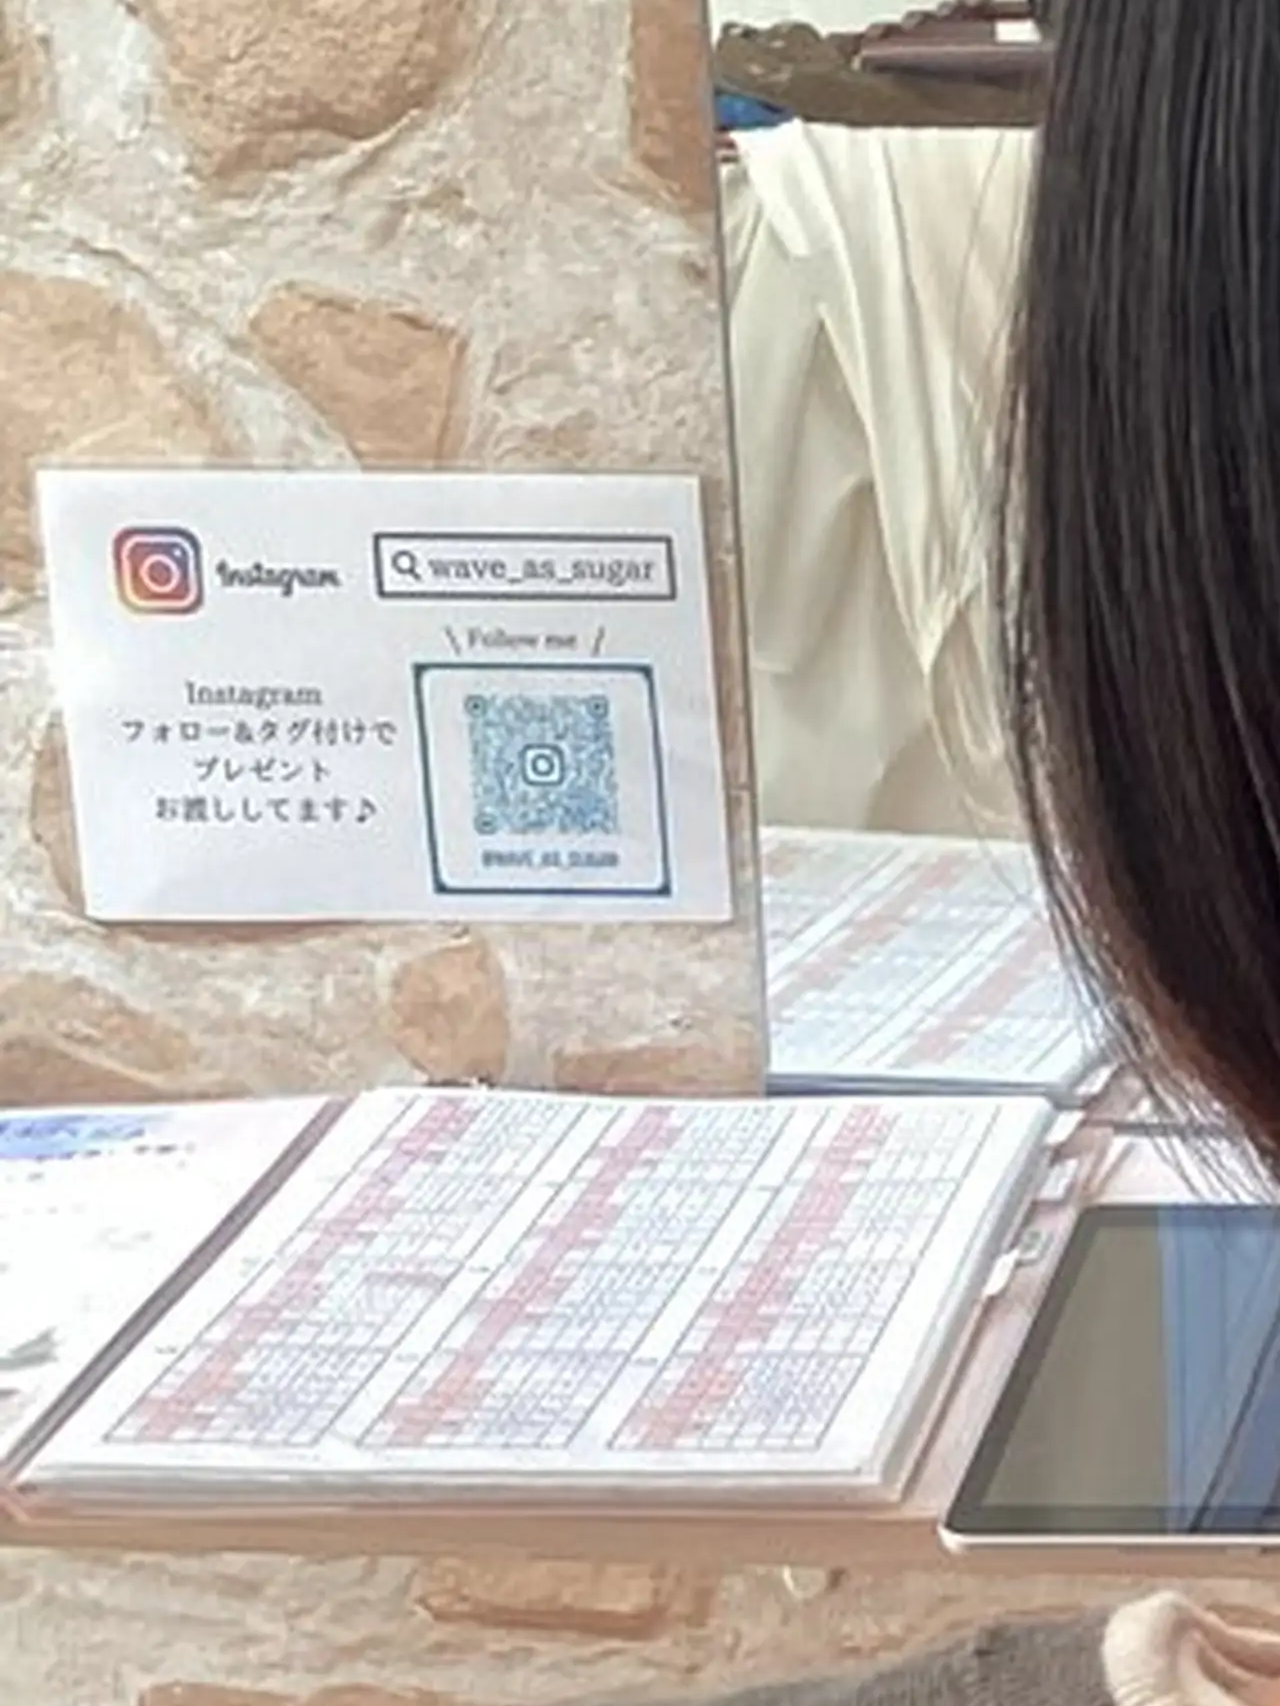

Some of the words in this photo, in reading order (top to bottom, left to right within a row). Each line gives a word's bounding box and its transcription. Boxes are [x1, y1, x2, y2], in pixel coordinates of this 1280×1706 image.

[215, 558, 342, 597] Instagram
[428, 557, 655, 586] wave_as_sugar
[186, 681, 323, 709] Instagram
[121, 717, 398, 746] フォロー&タグ付けで
[194, 756, 330, 782] プレゼント
